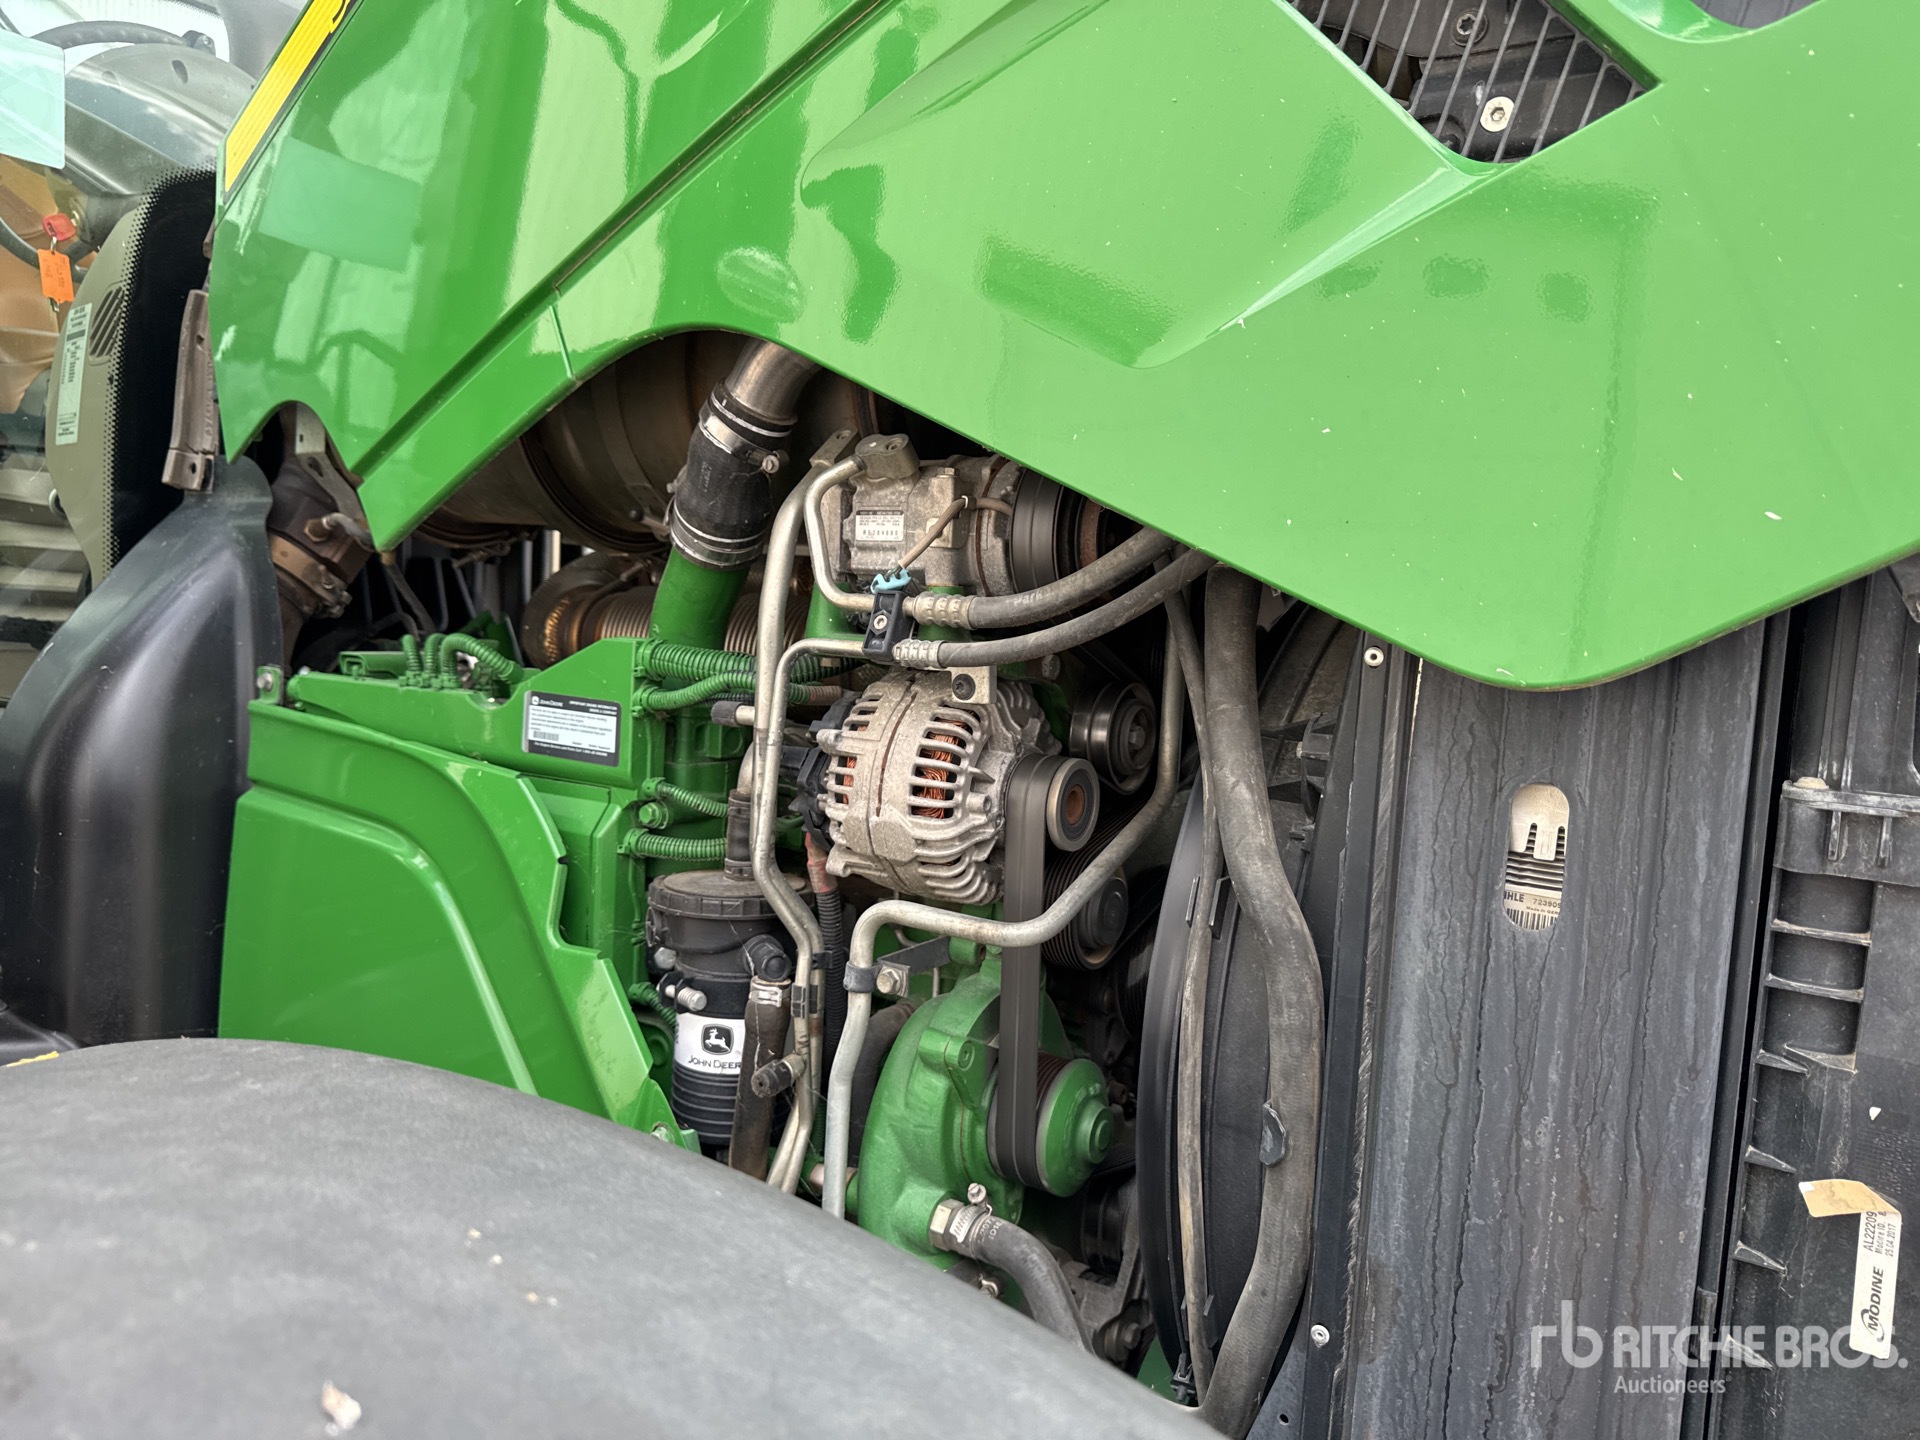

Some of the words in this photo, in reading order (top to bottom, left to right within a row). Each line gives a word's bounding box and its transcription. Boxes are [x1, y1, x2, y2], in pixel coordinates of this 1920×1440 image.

[688, 1055, 711, 1068] JOHN
[713, 1059, 741, 1069] DEER
[1867, 1266, 1884, 1331] MODINE
